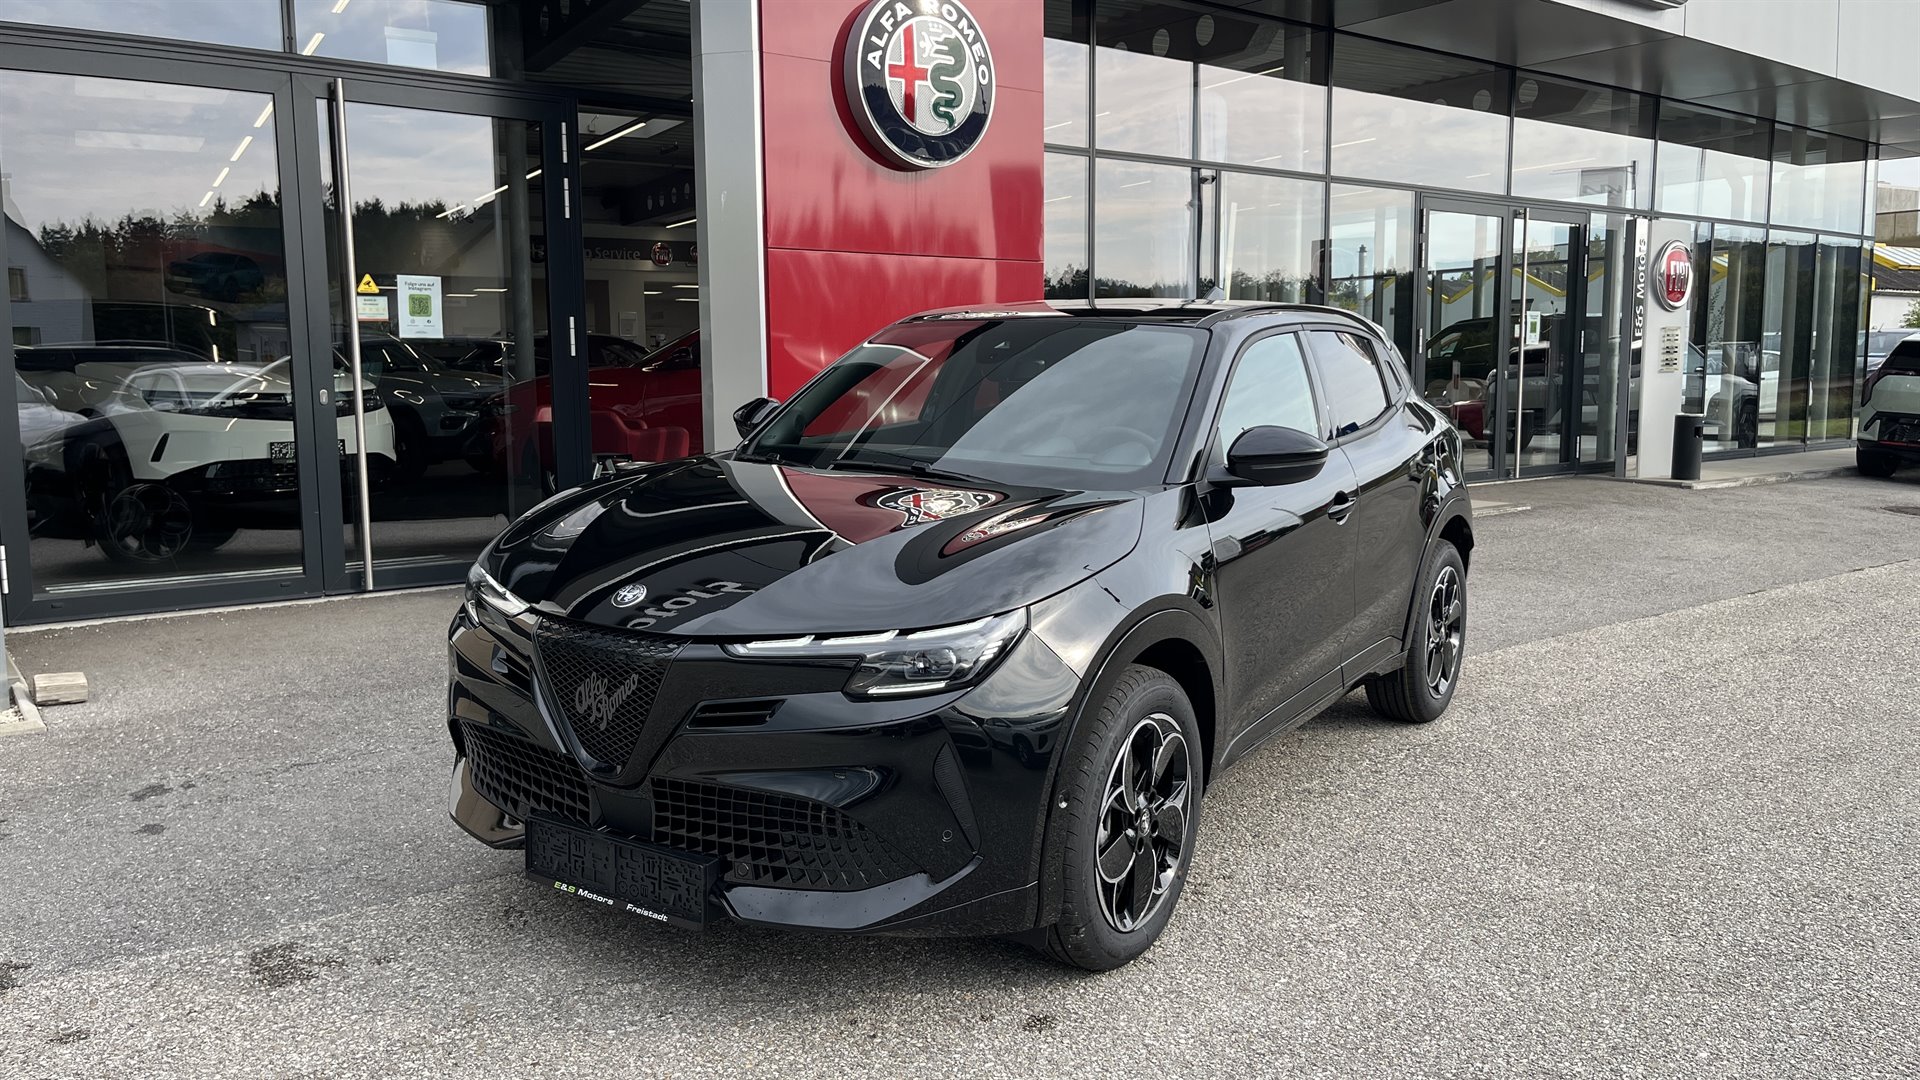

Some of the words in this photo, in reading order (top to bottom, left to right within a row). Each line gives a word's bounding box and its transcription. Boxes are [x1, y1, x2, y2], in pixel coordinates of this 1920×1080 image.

[867, 2, 913, 70] ALFA
[923, 0, 990, 86] ROMEO
[595, 247, 641, 260] Service
[1636, 238, 1647, 299] Motors
[1668, 260, 1691, 292] FIAT
[1635, 305, 1645, 336] E&S
[553, 881, 576, 894] E&S
[577, 888, 614, 906] Motors
[626, 903, 668, 922] Freistadt
